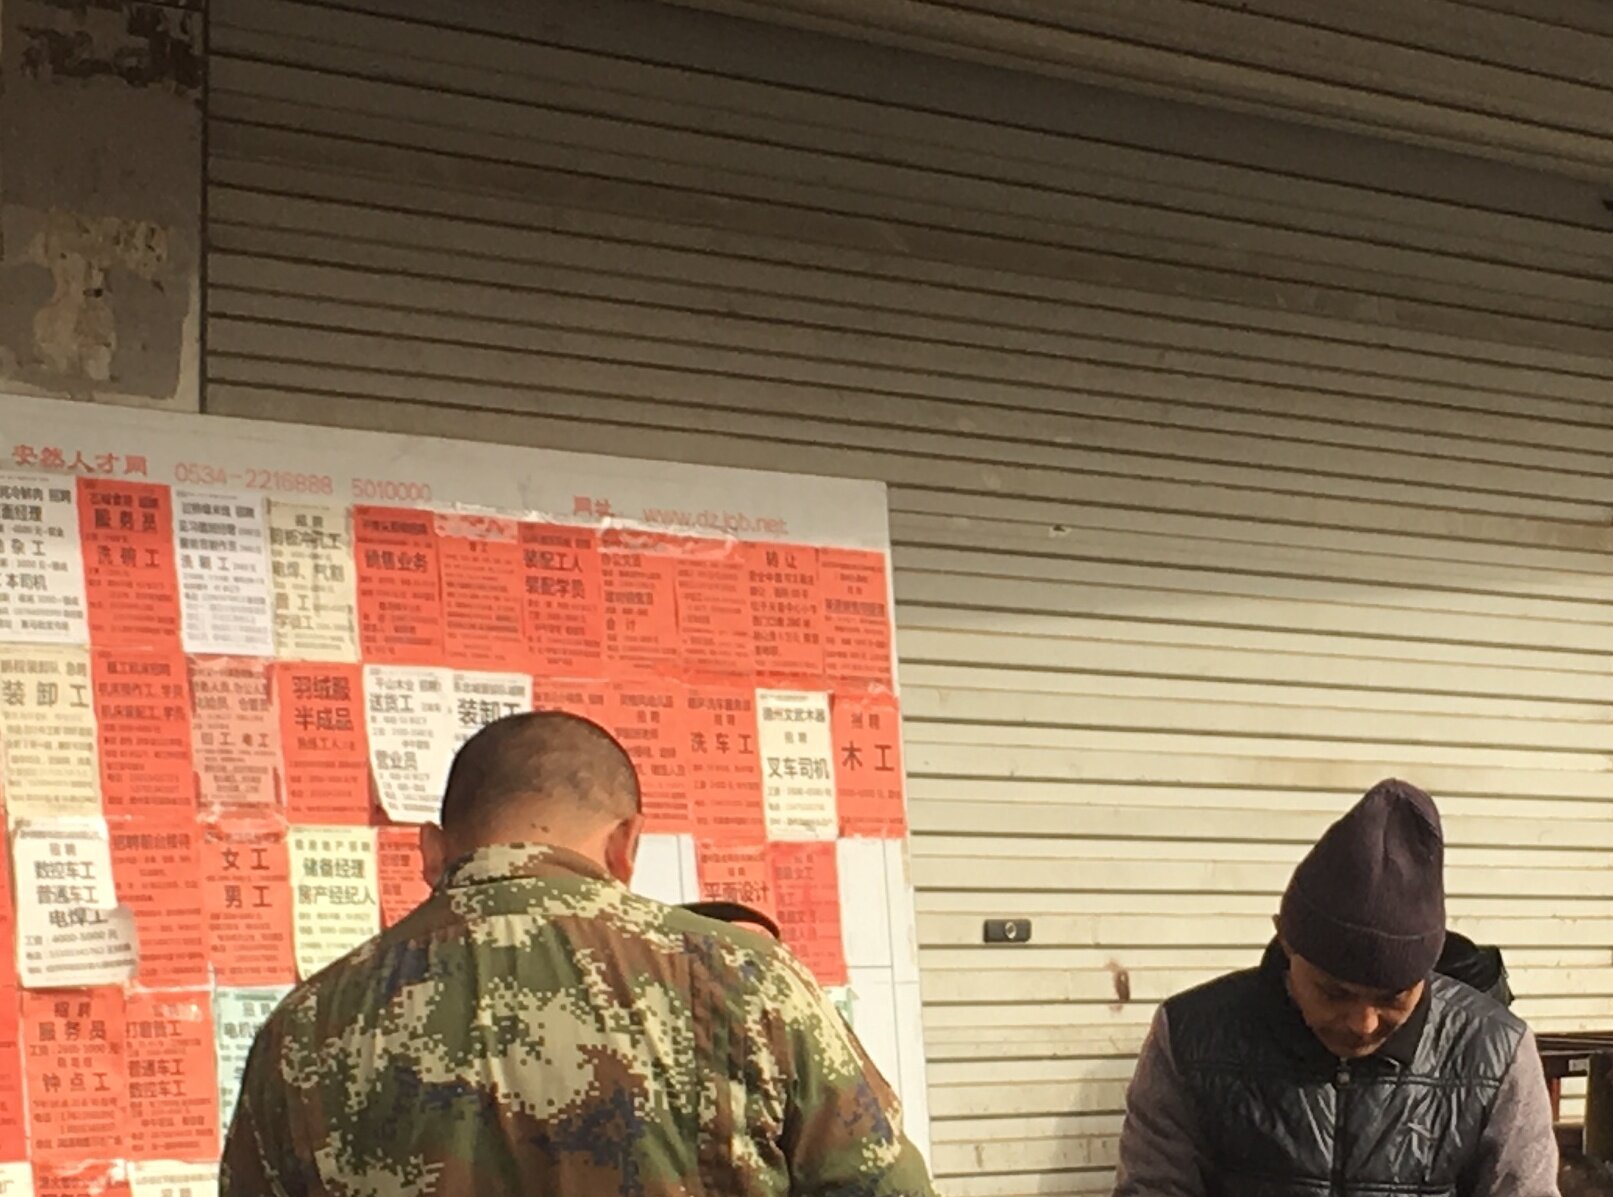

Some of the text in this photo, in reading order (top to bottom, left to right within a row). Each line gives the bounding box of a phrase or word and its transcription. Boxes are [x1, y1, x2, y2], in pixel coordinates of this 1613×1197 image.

[351, 478, 433, 502] 5010000
[95, 507, 157, 534] 服务员
[365, 548, 428, 573] 销售业务
[523, 548, 583, 574] 装配工人
[766, 551, 798, 570] 转让
[525, 575, 586, 600] 装配学员
[2, 679, 90, 708] 装卸工
[292, 675, 351, 702] 羽绒服
[295, 705, 355, 731] 半成品
[690, 731, 755, 755] 洗车工
[375, 749, 418, 772] 营业员
[841, 740, 895, 772] 木工
[766, 756, 831, 780] 叉车司机
[34, 860, 96, 880] 数控车工
[221, 848, 270, 871] 女工
[303, 857, 367, 879] 储备经理
[36, 885, 99, 905] 普通车工
[224, 884, 273, 909] 男工
[298, 884, 376, 906] 房产经纪人
[703, 881, 770, 903] 平面设计
[48, 907, 109, 928] 电焊工
[38, 1020, 107, 1041] 服务员
[128, 1058, 185, 1077] 普通车工
[42, 1072, 110, 1093] 钟点工
[129, 1081, 186, 1098] 数控车工
